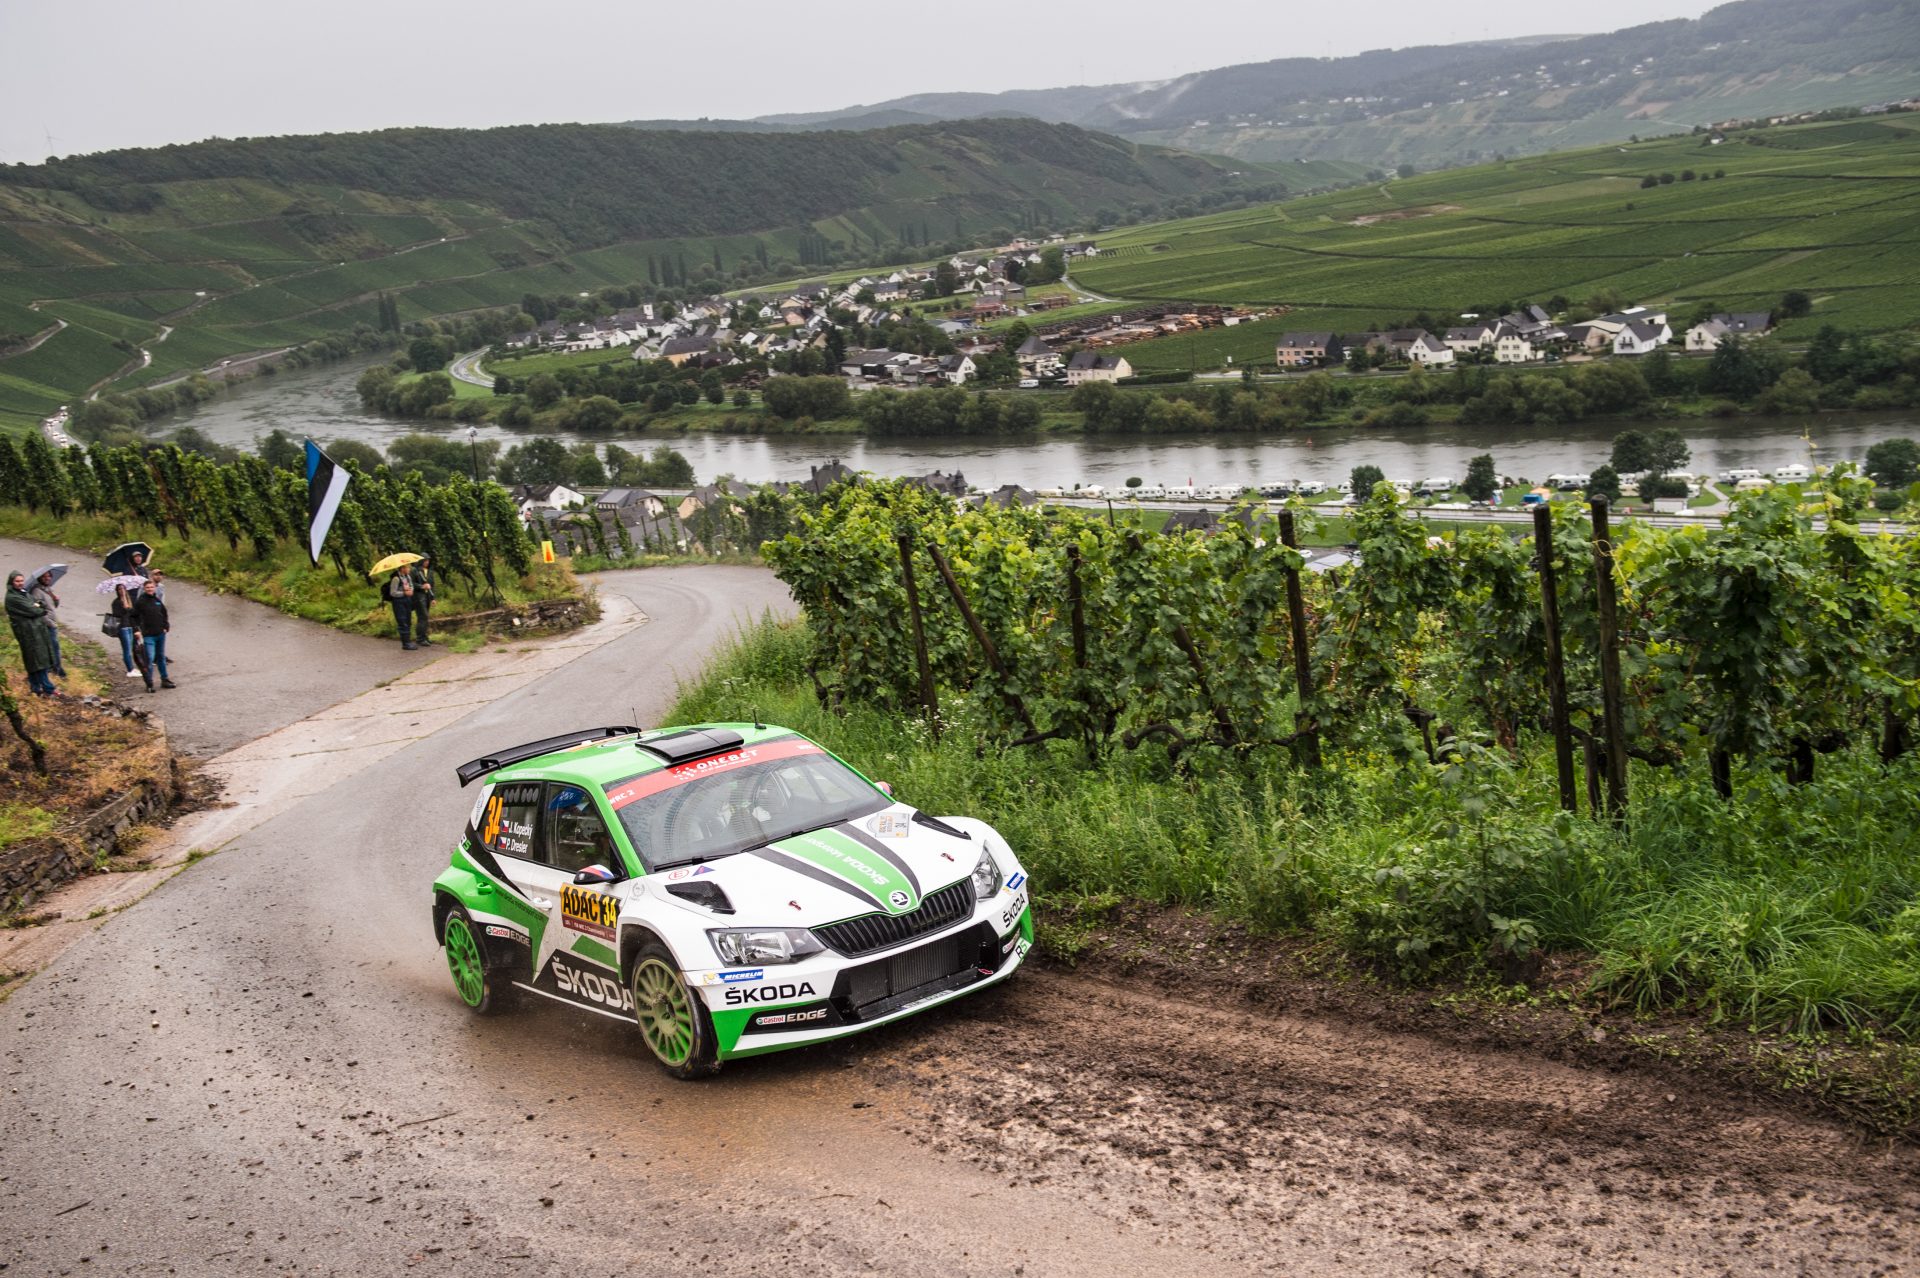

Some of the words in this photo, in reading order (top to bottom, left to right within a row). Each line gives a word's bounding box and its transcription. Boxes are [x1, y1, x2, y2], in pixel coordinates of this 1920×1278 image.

[696, 749, 758, 770] ONEBET
[626, 789, 636, 797] 2
[484, 795, 504, 845] 34
[508, 821, 514, 833] J.
[513, 821, 534, 840] Kopecký
[505, 836, 511, 851] P.
[511, 838, 528, 854] Dresler
[843, 855, 891, 885] ŠKODA
[562, 886, 599, 922] ADAC
[602, 895, 618, 929] 34
[1002, 893, 1026, 929] ŠKODA
[492, 927, 509, 937] Castrol
[510, 930, 532, 947] EDGE
[1015, 940, 1028, 959] R5
[551, 955, 635, 1011] ŠKODA
[724, 971, 763, 980] MICHELIN
[724, 982, 816, 1005] ŠKODA
[763, 1015, 785, 1024] Castrol
[786, 1008, 828, 1023] EDGE
